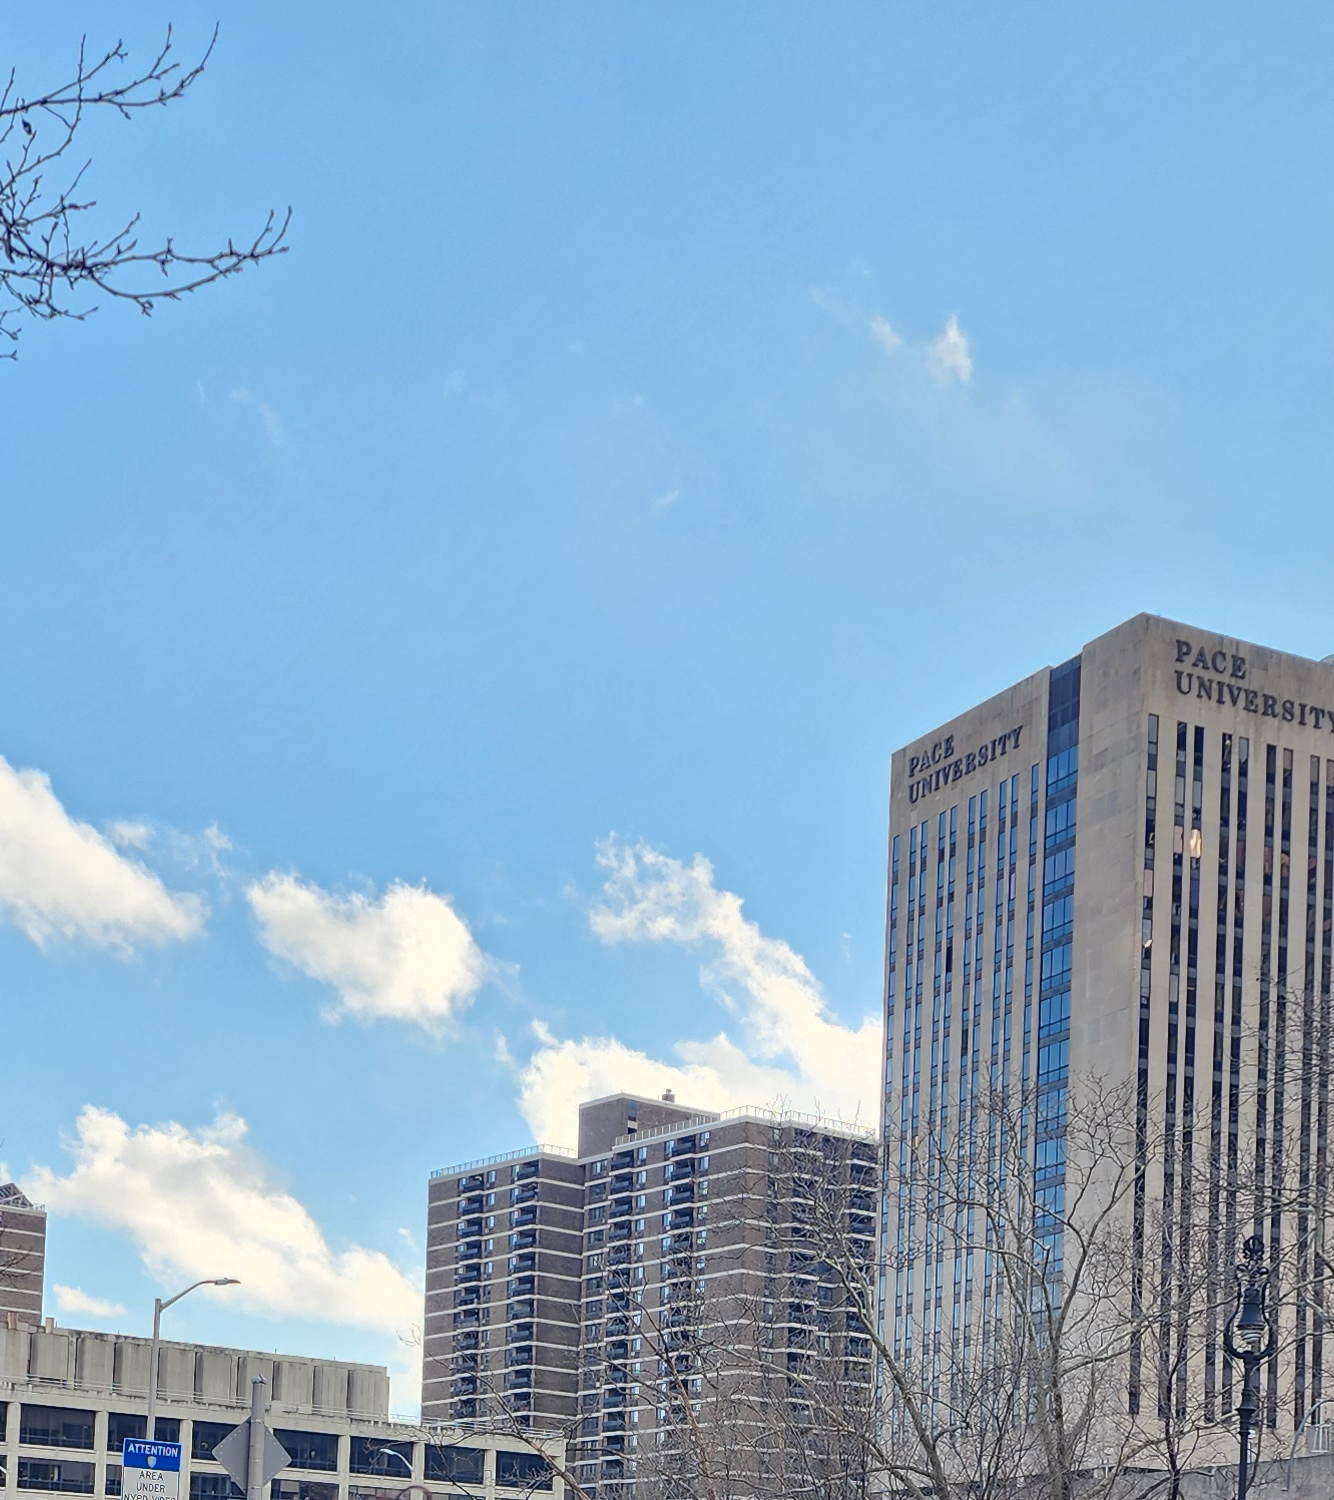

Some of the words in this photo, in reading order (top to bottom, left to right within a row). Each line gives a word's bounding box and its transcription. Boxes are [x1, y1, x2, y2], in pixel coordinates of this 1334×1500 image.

[1174, 638, 1247, 680] PACE
[908, 734, 955, 779] PACE
[908, 724, 1024, 804] UNIVERSITY
[127, 1442, 179, 1457] ATTENTION
[136, 1482, 166, 1493] UNDER
[138, 1470, 164, 1481] AREA
